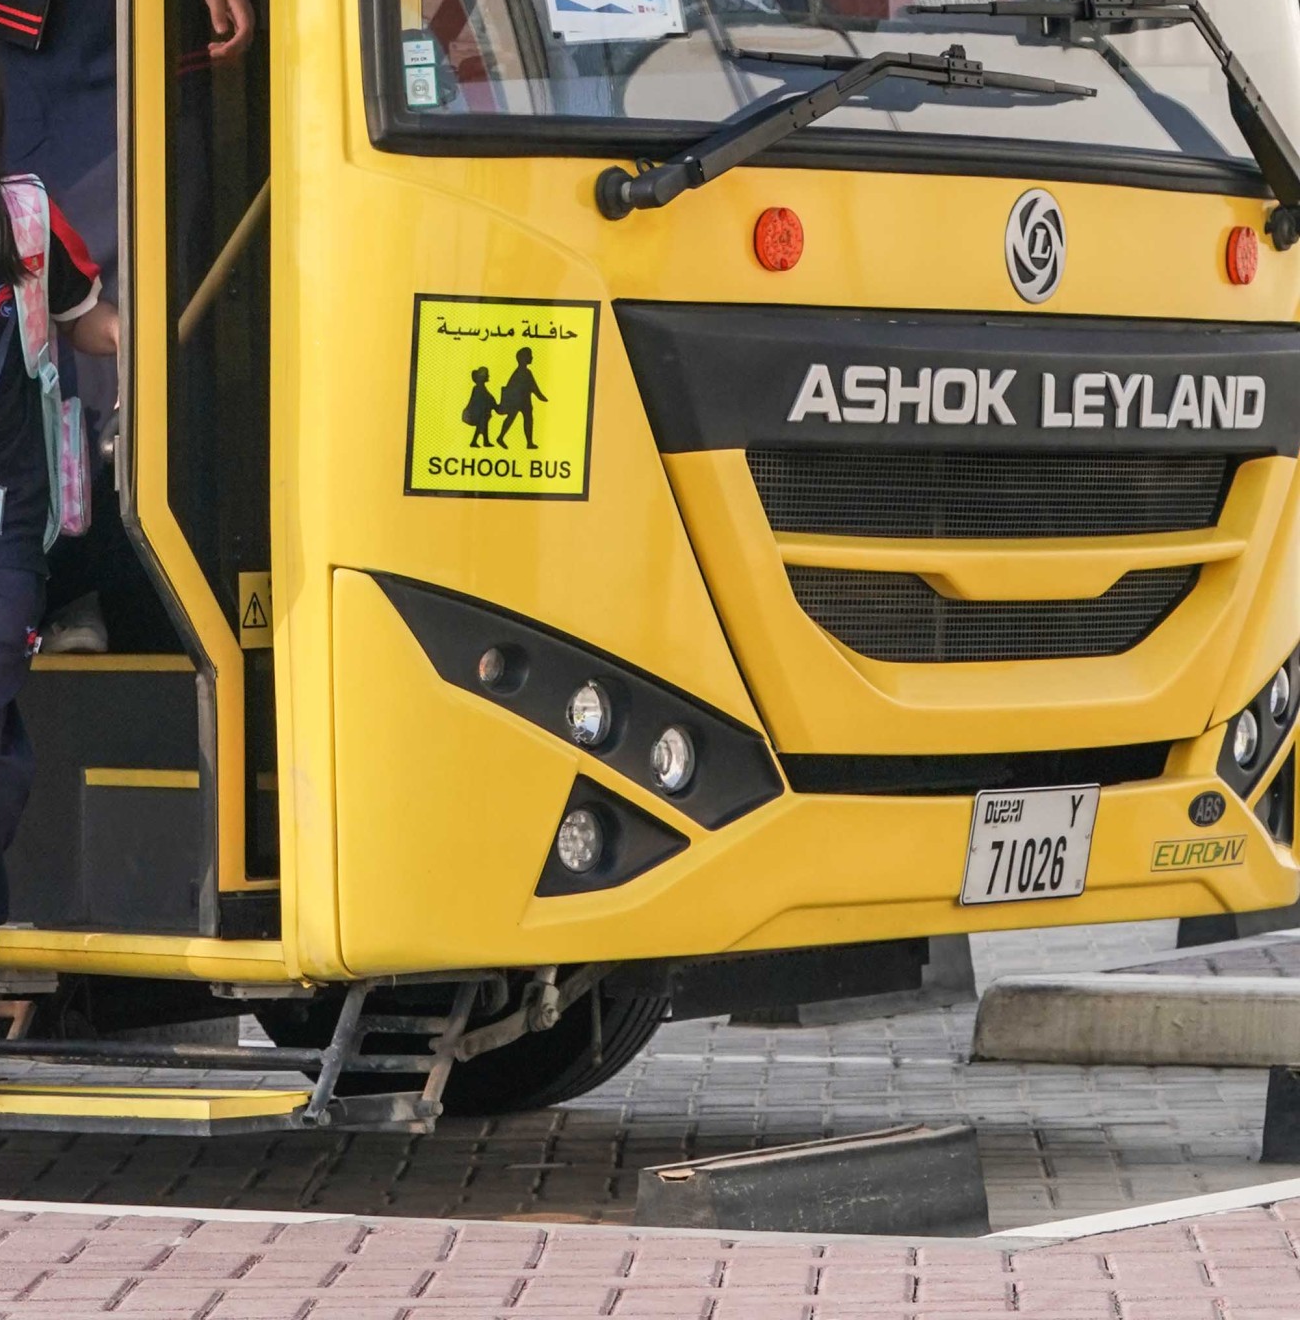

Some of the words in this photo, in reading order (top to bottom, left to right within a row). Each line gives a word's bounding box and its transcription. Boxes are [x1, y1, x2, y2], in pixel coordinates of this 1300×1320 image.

[1031, 228, 1051, 260] L
[436, 316, 516, 341] مدرسية
[521, 320, 579, 340] حافلة
[787, 363, 1017, 425] ASHOK
[1041, 371, 1266, 429] LEYLAND
[428, 456, 523, 478] SCHOOL
[529, 460, 572, 479] BUS
[1070, 794, 1085, 829] Y
[1195, 796, 1222, 822] ABS
[986, 835, 1068, 896] 71026
